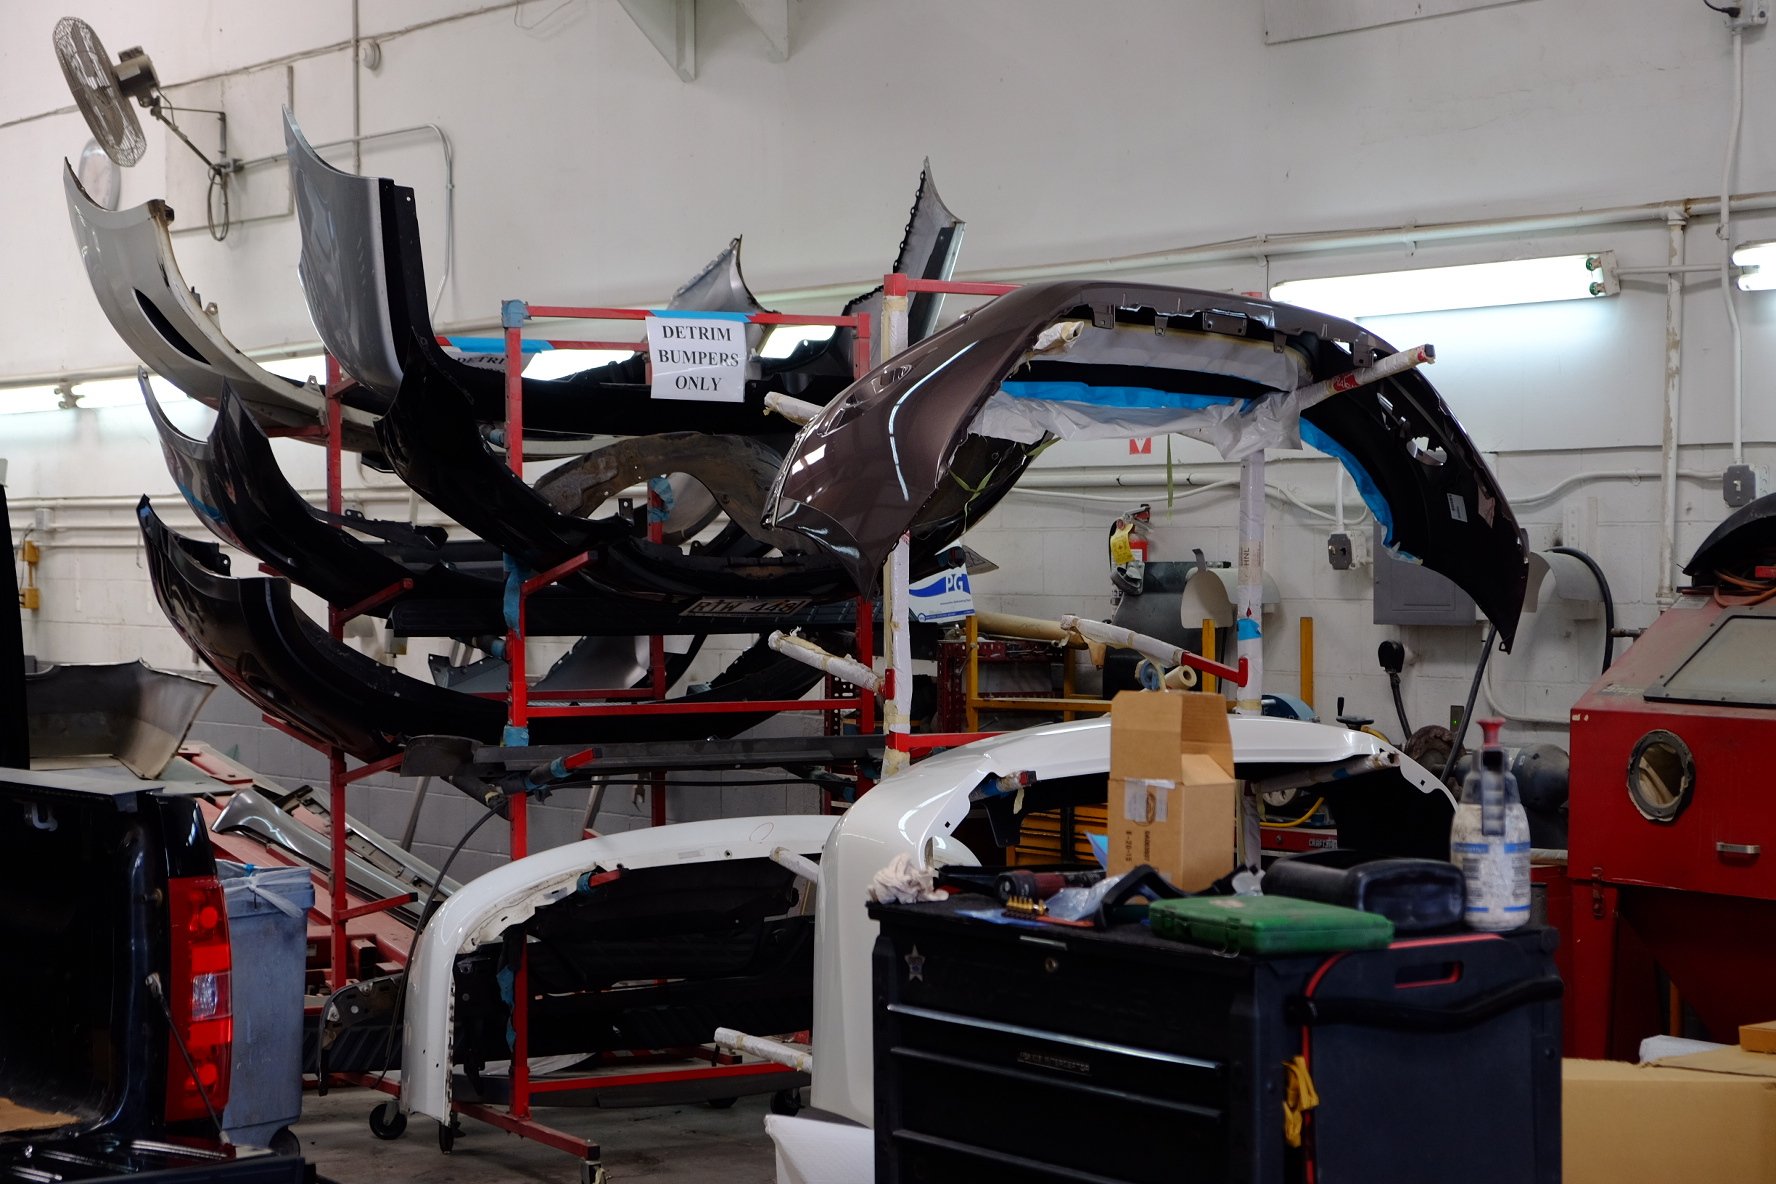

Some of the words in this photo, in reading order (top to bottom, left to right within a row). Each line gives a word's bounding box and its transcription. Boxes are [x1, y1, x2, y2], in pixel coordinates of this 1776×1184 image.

[662, 325, 731, 342] DETRIM
[458, 355, 508, 365] DETRI
[658, 349, 739, 367] BUMPERS
[675, 375, 722, 391] ONLY
